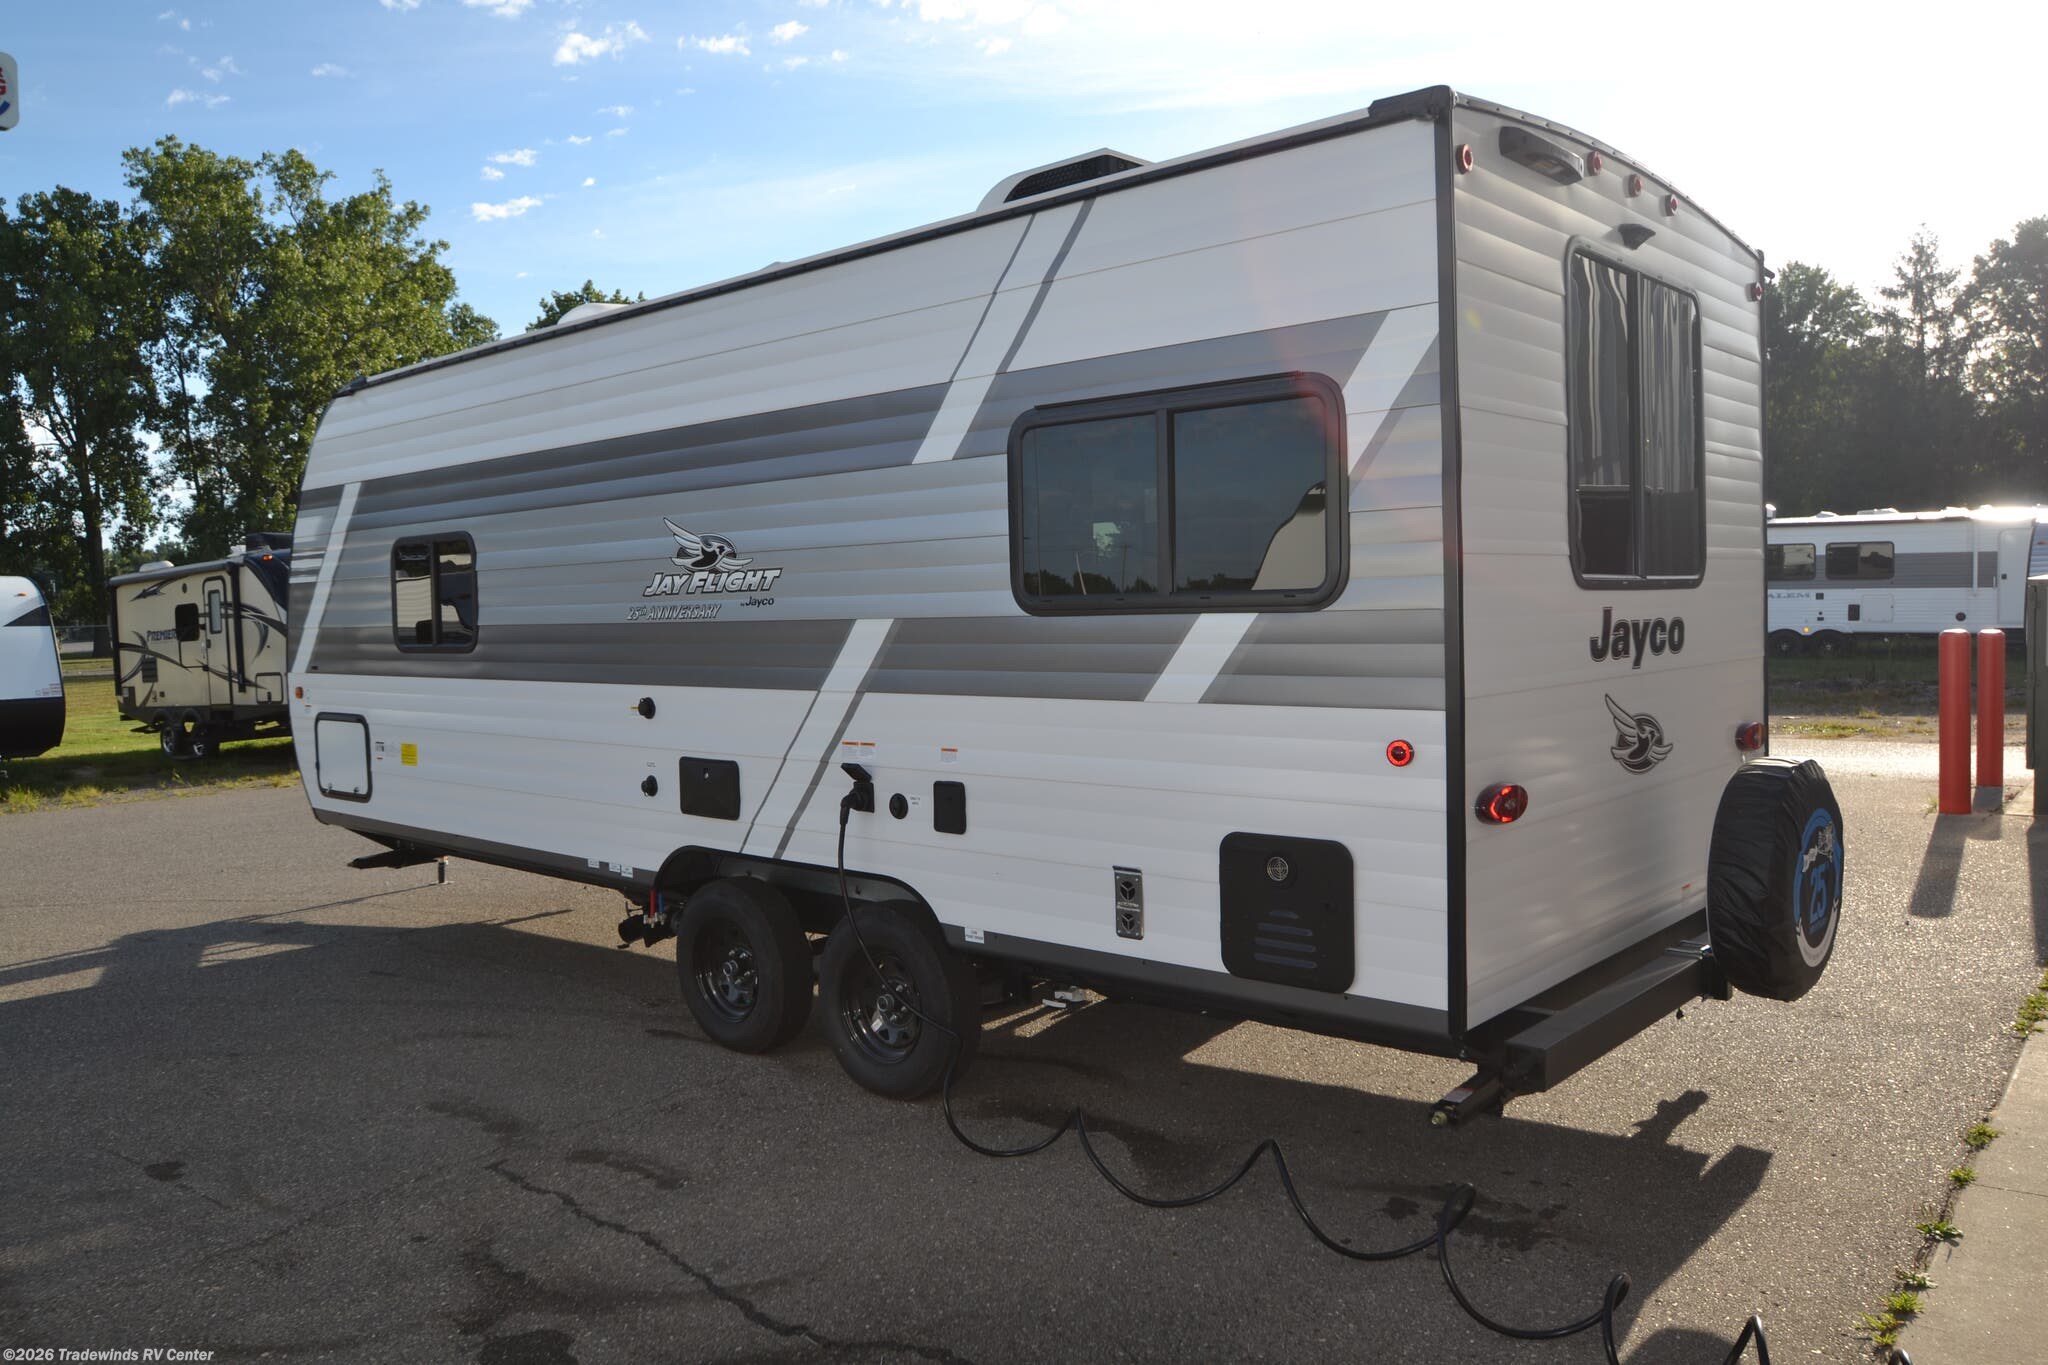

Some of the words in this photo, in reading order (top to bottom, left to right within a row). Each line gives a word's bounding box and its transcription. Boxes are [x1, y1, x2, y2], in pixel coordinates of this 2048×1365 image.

[643, 572, 692, 597] JAY
[687, 567, 784, 595] FLIGHT
[647, 604, 722, 620] ANNIVERSARY
[745, 596, 775, 608] Jayco
[1590, 606, 1685, 669] Jayco
[1810, 862, 1827, 926] 25
